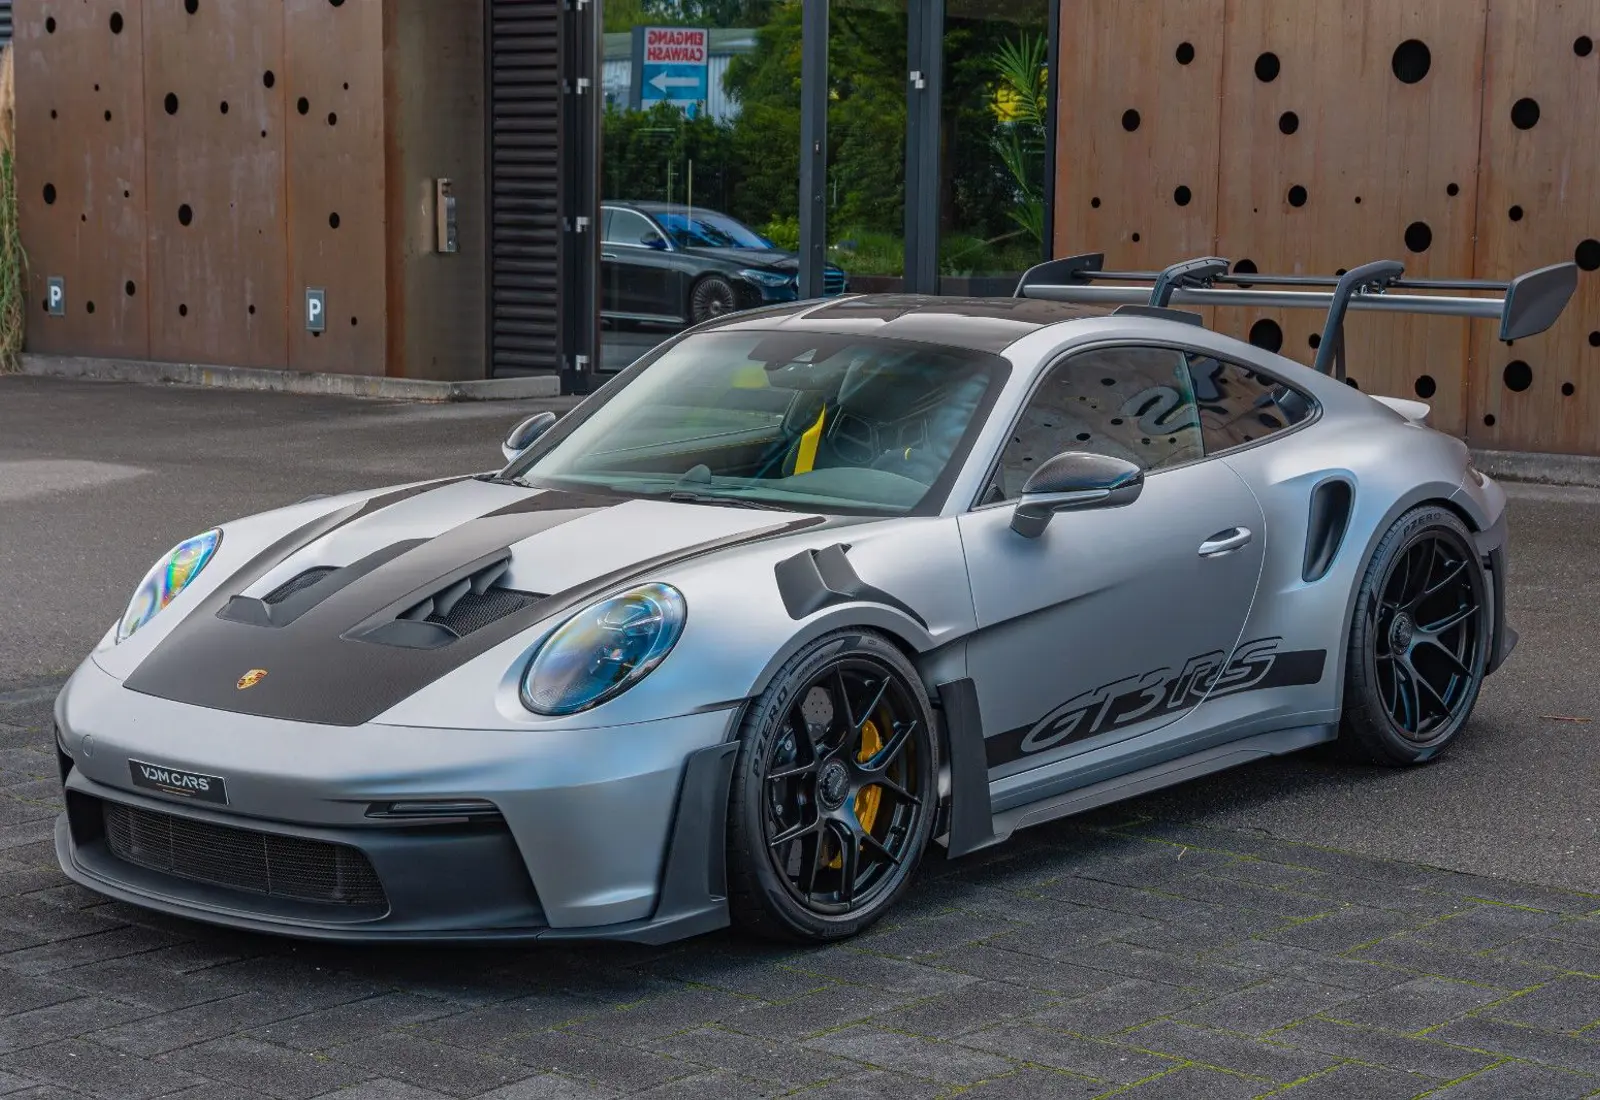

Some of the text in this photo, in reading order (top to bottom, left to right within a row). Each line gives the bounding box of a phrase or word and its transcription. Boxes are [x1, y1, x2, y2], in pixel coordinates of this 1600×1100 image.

[50, 285, 62, 307] P
[309, 298, 321, 321] P
[140, 764, 170, 784] VDM
[171, 773, 210, 791] CARS
